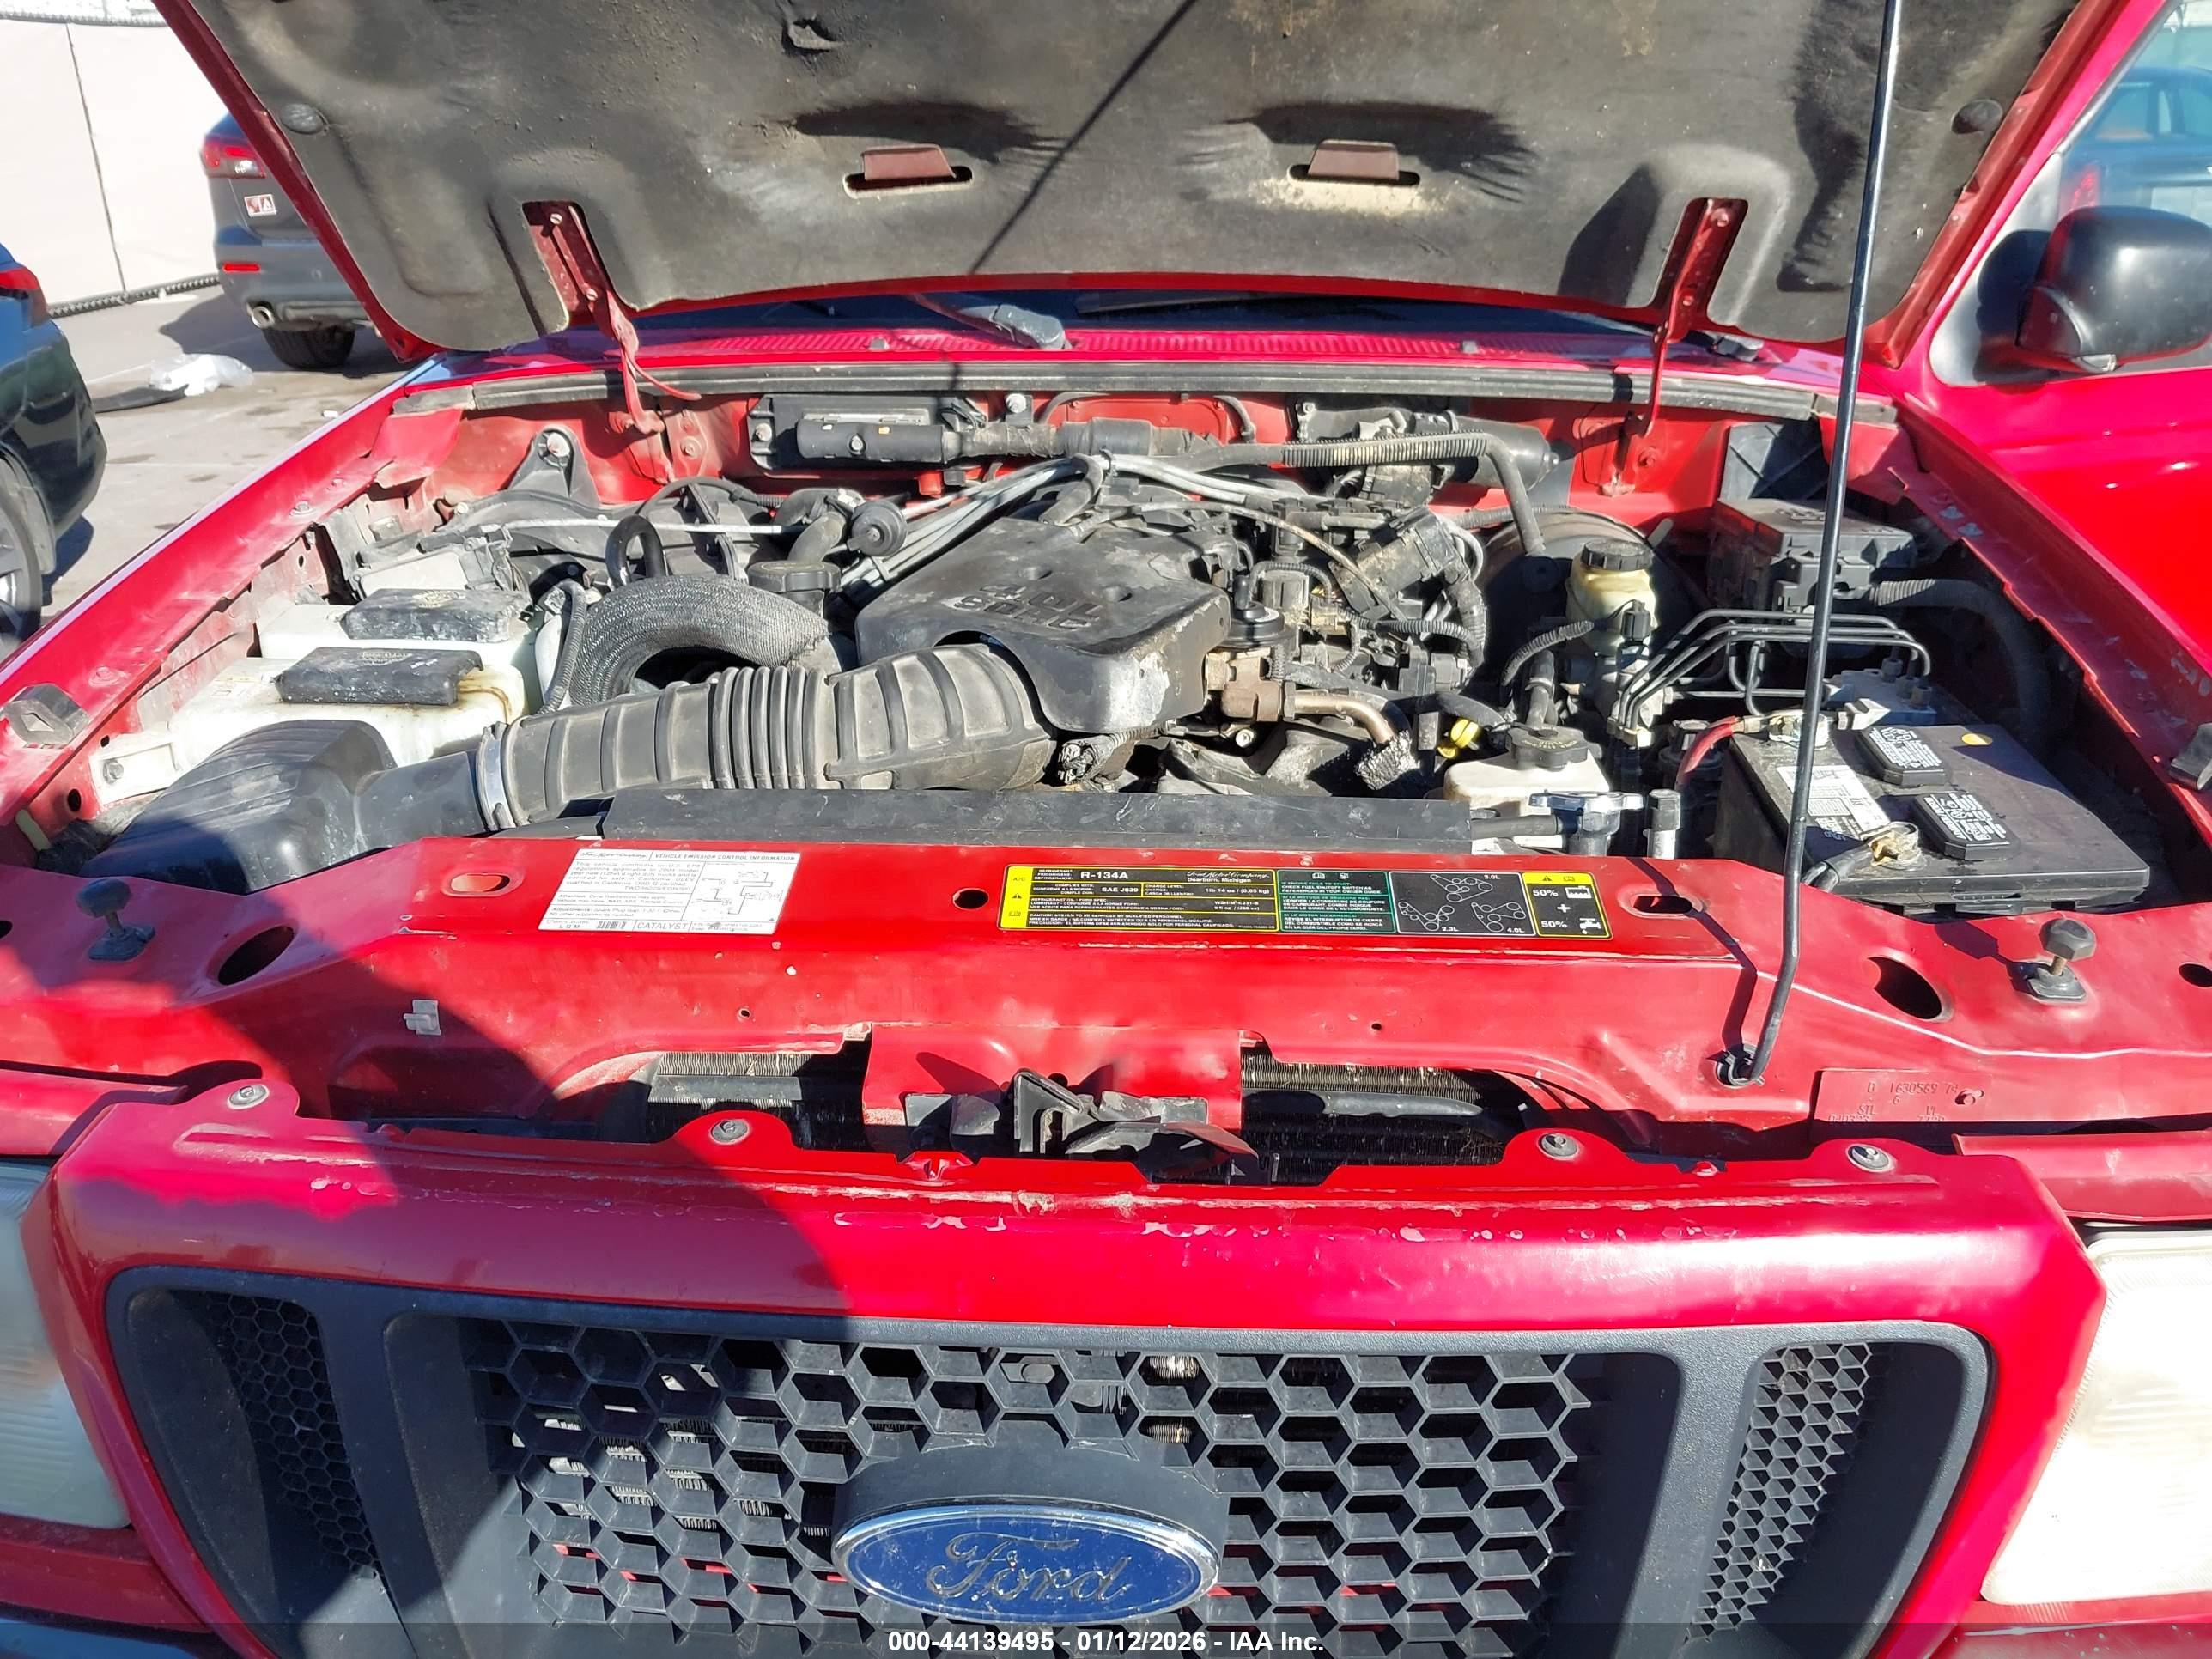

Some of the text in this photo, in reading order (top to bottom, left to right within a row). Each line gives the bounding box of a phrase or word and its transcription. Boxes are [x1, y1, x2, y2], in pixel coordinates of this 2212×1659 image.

[1080, 871, 1129, 879] R-134A
[1532, 889, 1559, 897] 50%
[1541, 920, 1568, 928] 50%
[926, 1532, 1133, 1601] Ford
